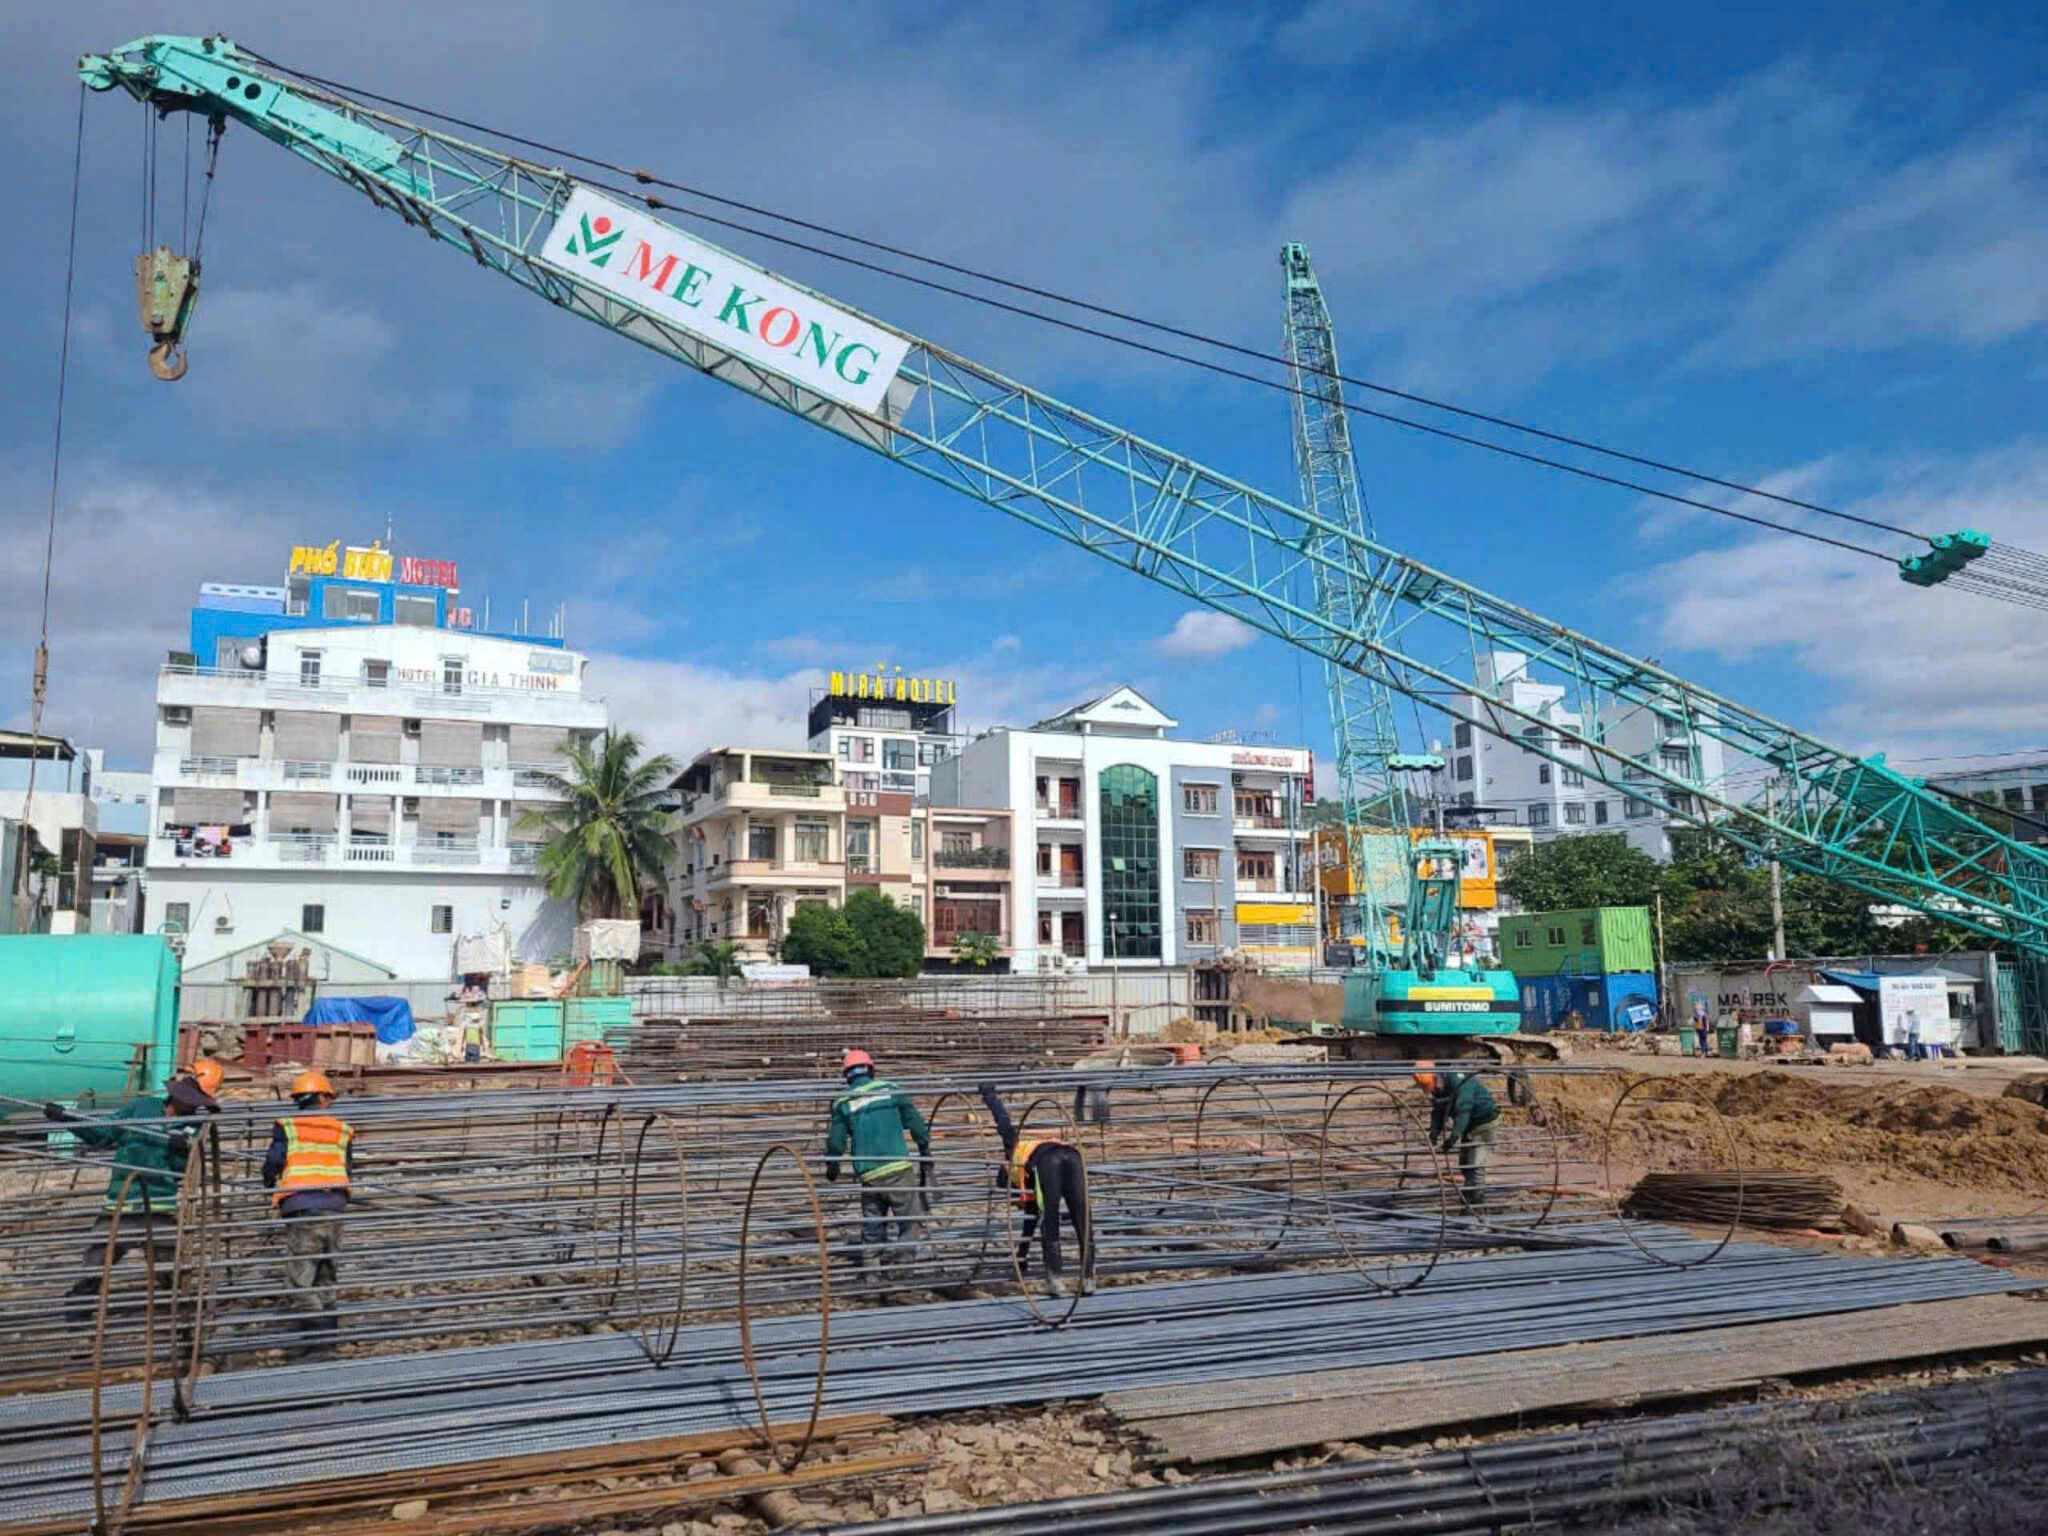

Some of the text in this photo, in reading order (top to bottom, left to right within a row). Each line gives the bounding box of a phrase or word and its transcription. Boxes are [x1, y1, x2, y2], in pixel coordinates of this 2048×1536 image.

[621, 240, 882, 385] ME KONG
[830, 671, 956, 705] MIRA HOTEL
[1424, 1001, 1490, 1012] SUMITOMO
[1718, 992, 1788, 1006] MARSK
